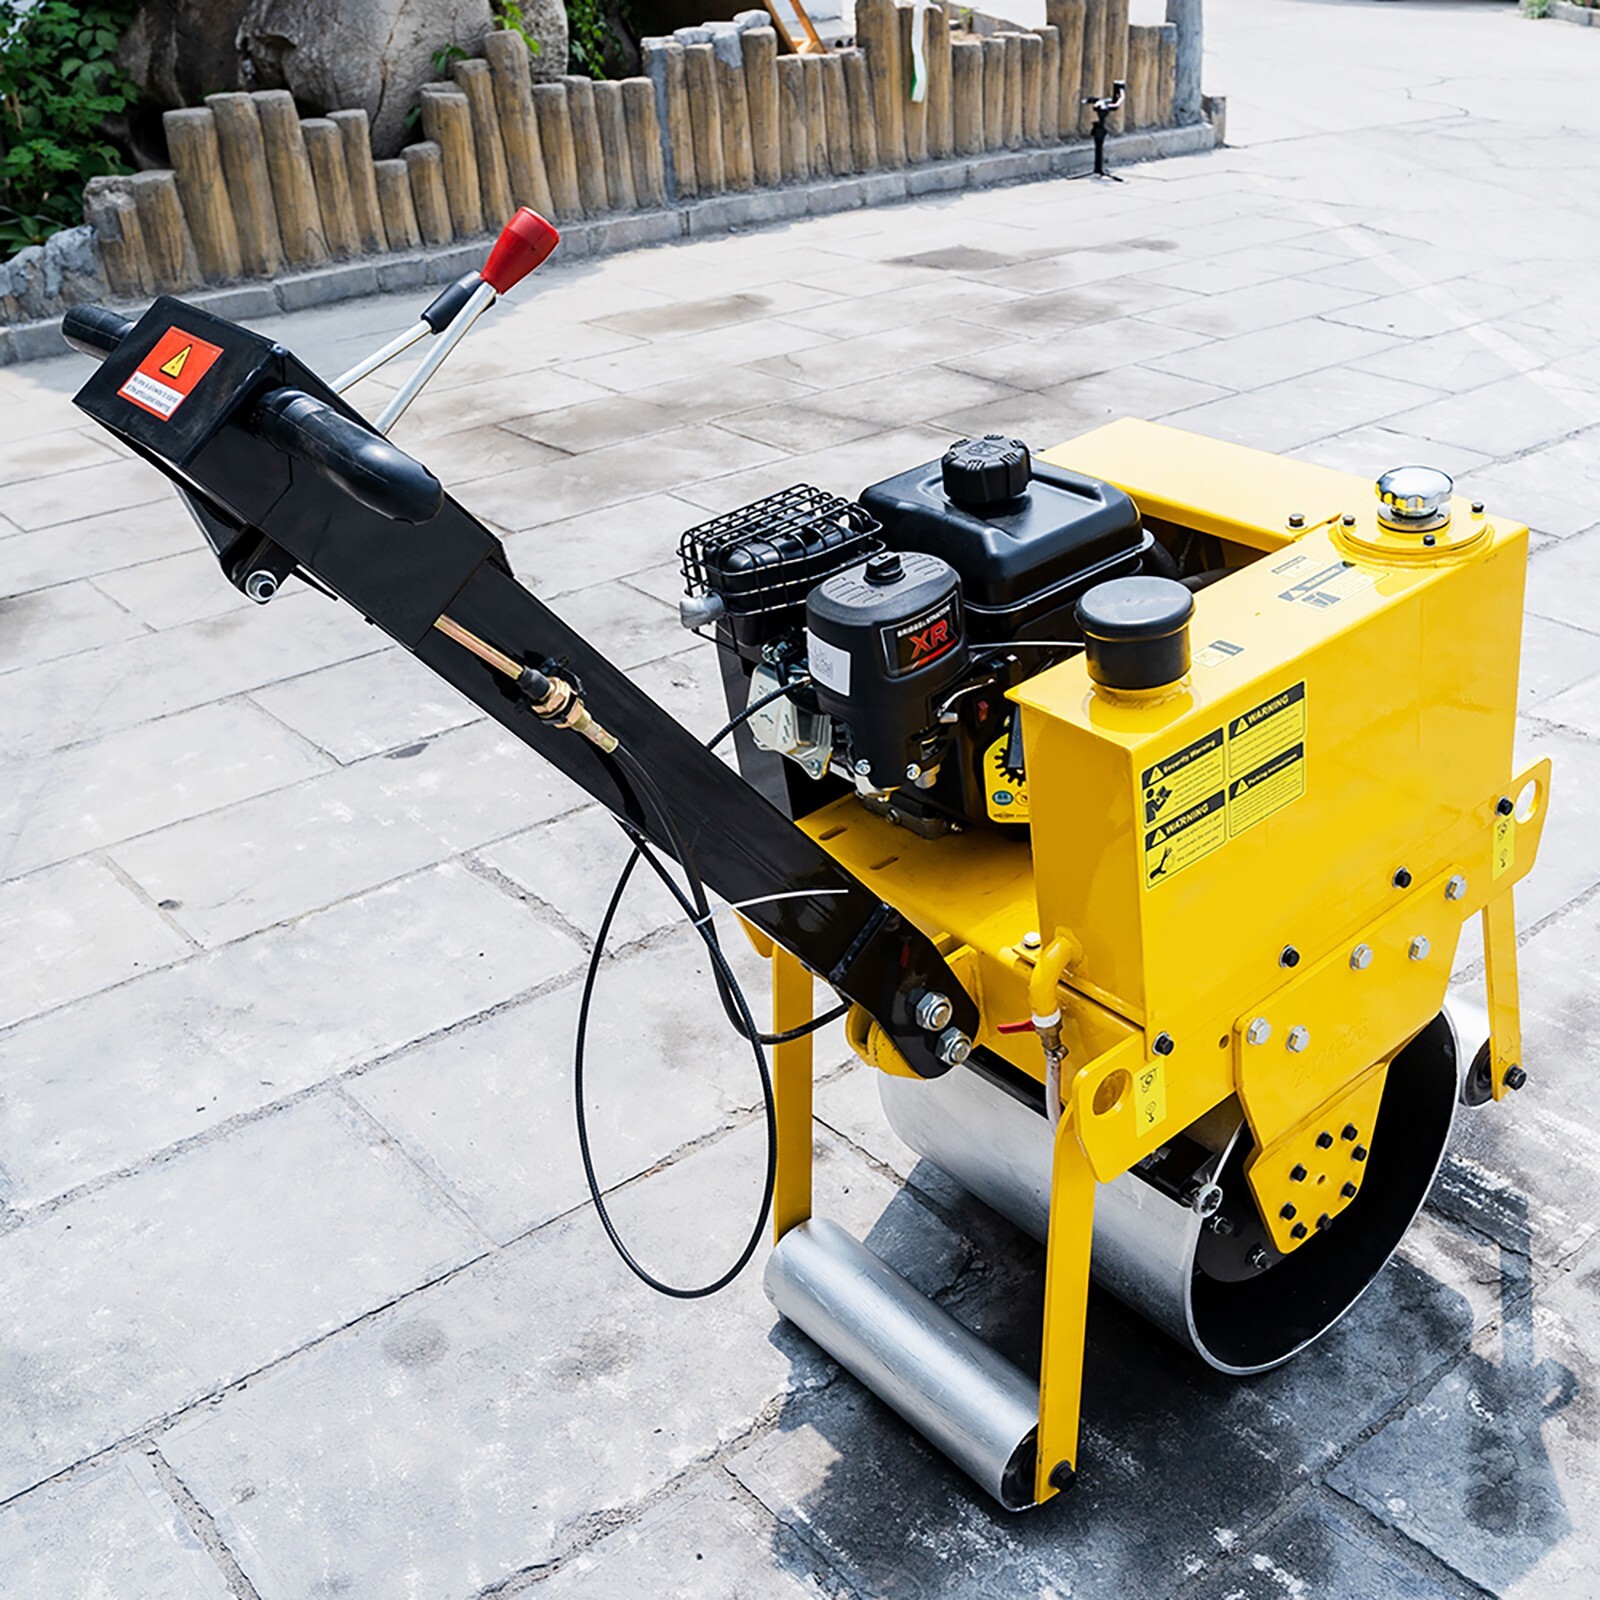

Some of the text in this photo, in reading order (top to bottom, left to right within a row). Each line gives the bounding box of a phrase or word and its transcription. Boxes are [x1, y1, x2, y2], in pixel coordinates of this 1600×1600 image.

[909, 619, 948, 660] XR
[1247, 694, 1289, 724] WARNING
[1165, 803, 1209, 834] WARNING
